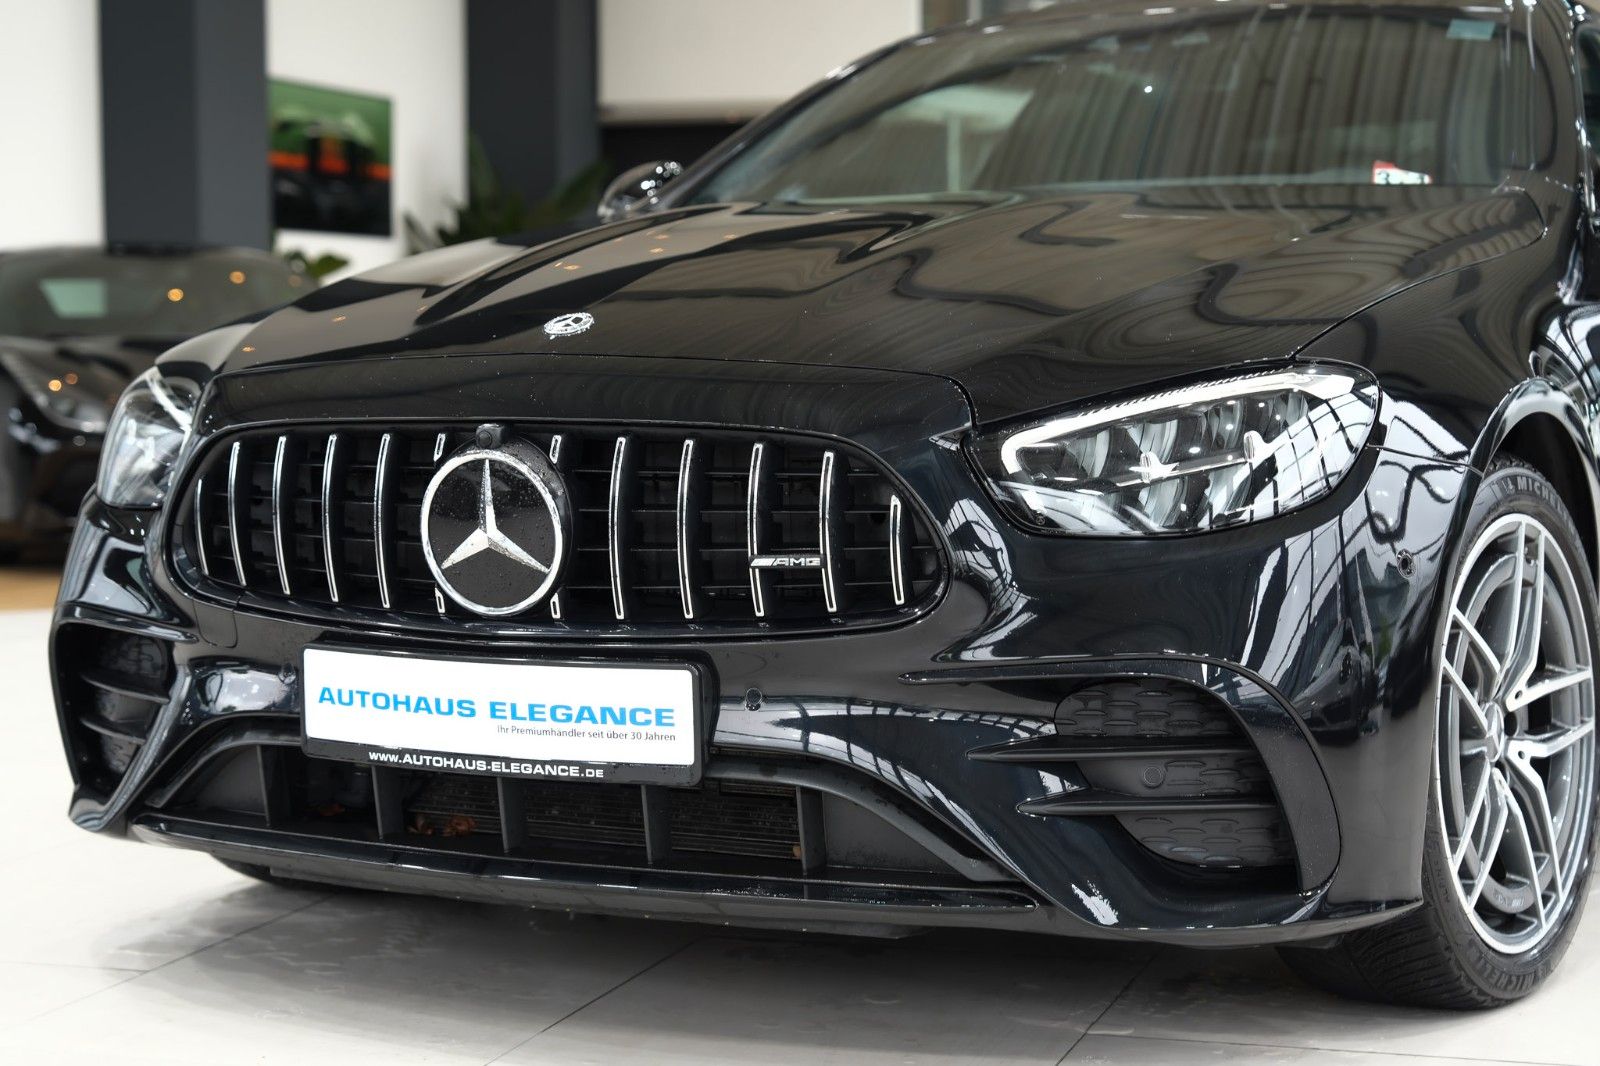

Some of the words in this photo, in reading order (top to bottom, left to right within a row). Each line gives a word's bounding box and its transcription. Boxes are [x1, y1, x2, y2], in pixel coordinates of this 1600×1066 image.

[772, 557, 821, 566] AMG
[318, 686, 477, 718] AUTOHAUS
[489, 701, 675, 727] ELEGANCE
[497, 724, 509, 734] Ihr
[511, 725, 585, 738] Premiumhändler
[588, 729, 604, 739] seit
[607, 729, 628, 740] über
[630, 732, 642, 740] 30
[644, 731, 676, 742] Jahren
